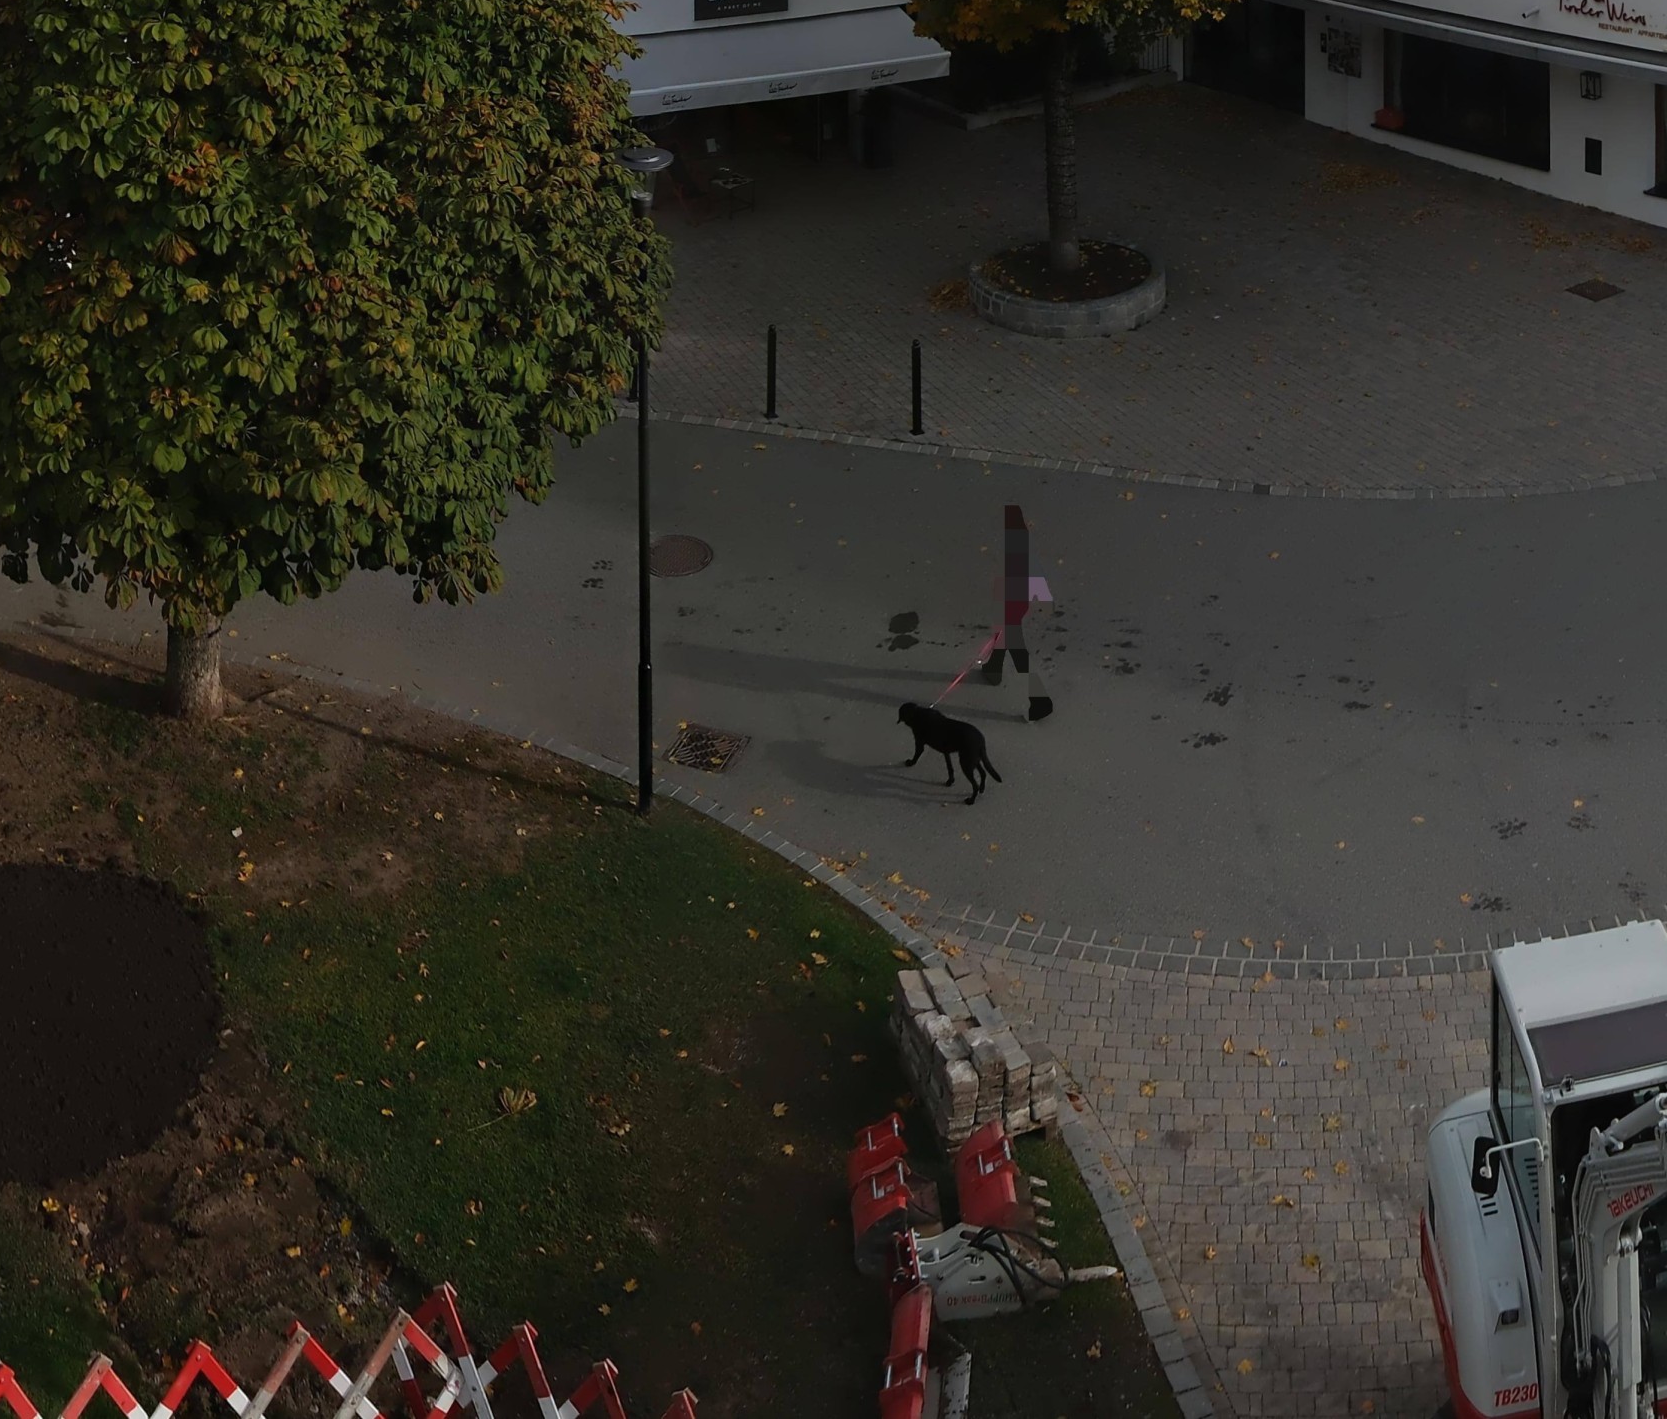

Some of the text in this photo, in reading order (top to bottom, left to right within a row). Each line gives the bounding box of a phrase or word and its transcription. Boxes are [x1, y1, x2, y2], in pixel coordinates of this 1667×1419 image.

[1599, 22, 1633, 34] RESTAURANT
[1607, 1183, 1654, 1218] TAKEUCHI
[1494, 1384, 1537, 1407] TB230
